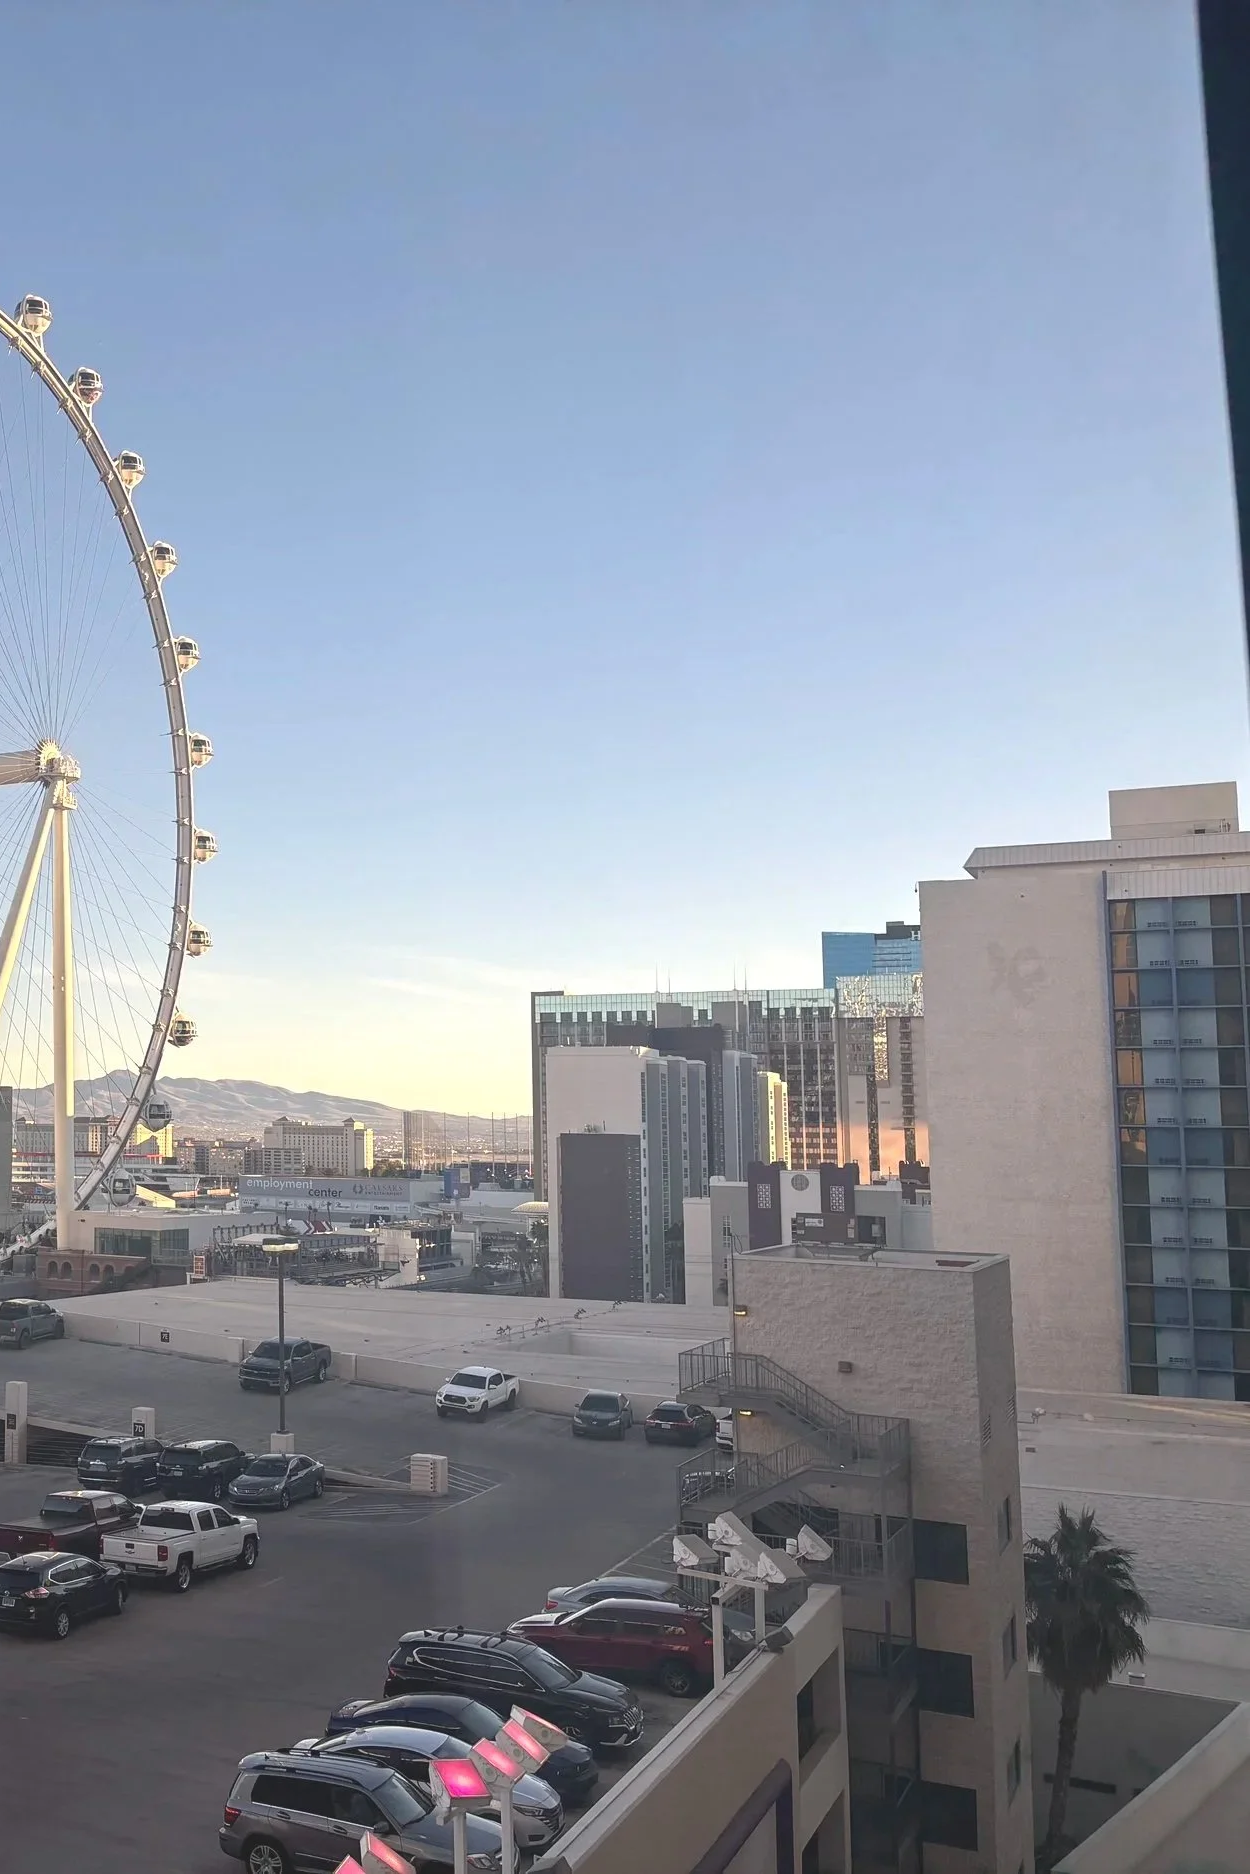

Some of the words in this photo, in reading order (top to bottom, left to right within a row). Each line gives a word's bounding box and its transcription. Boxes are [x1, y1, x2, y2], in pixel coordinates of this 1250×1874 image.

[246, 1177, 313, 1191] employment
[308, 1188, 343, 1198] center
[134, 1424, 144, 1433] 7D
